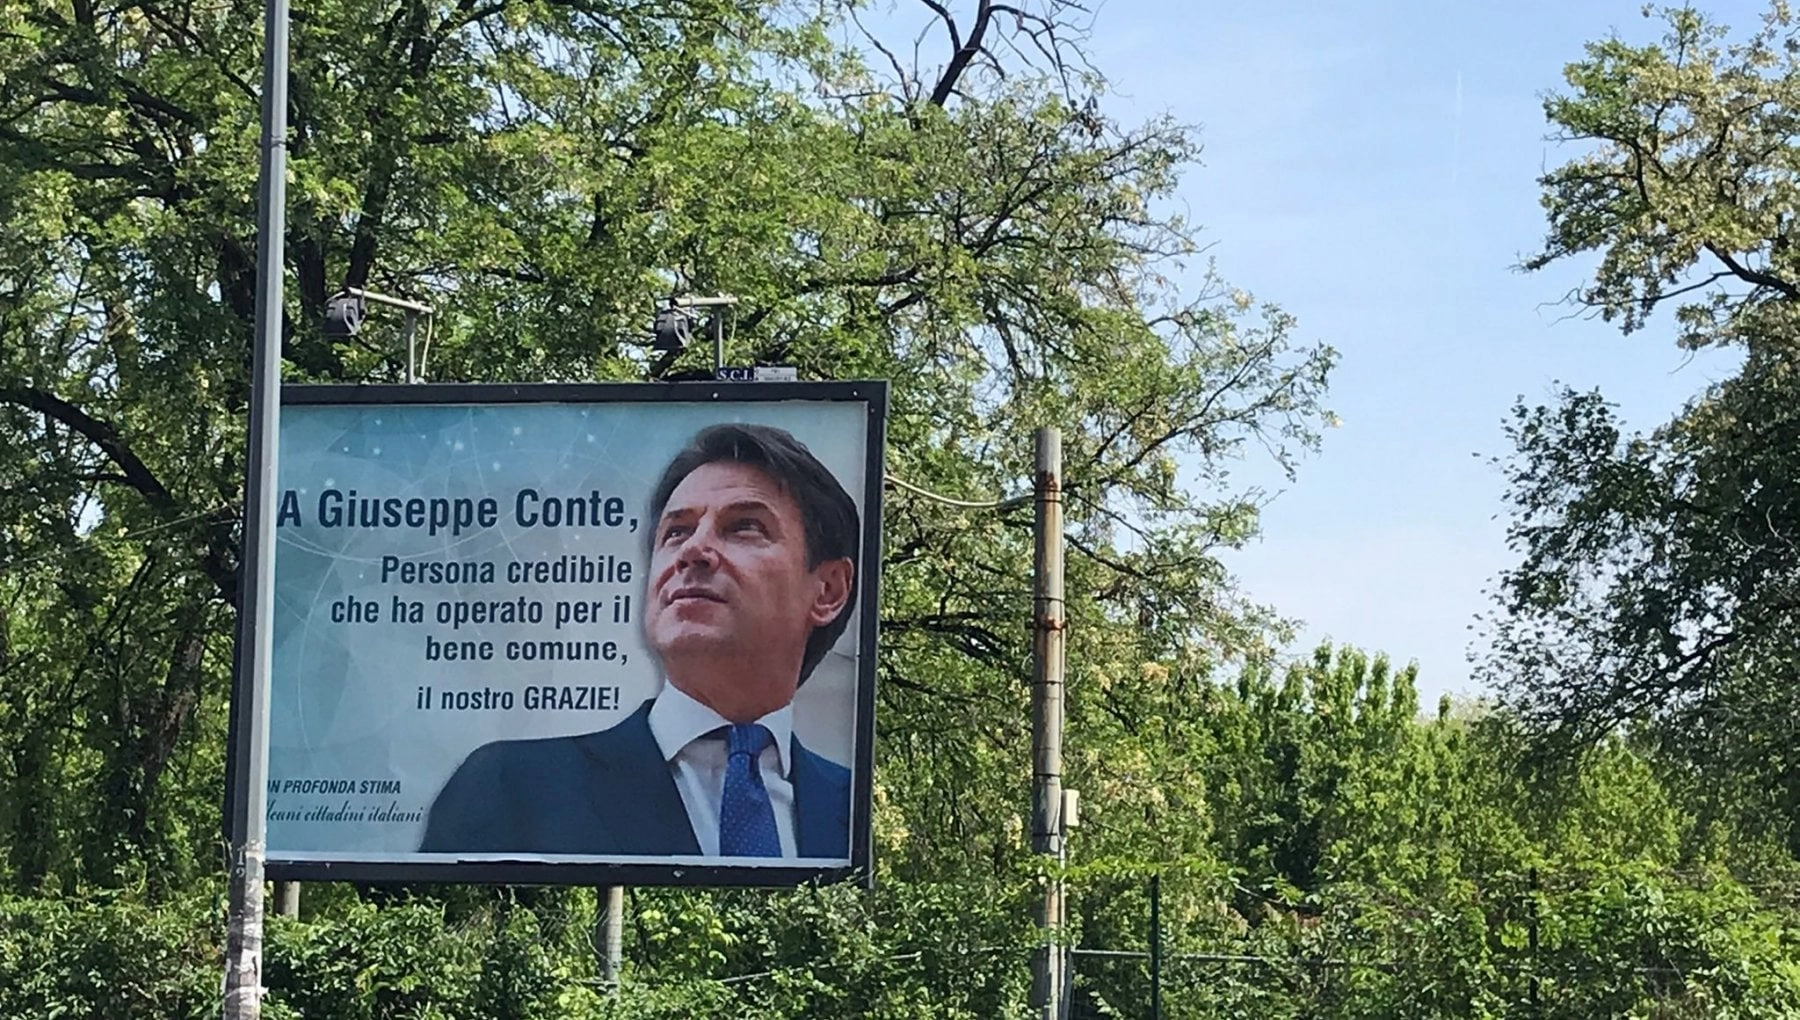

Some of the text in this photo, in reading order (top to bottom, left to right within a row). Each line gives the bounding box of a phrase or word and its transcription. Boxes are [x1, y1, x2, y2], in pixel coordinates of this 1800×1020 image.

[277, 488, 638, 536] A Giuseppe Conte,
[381, 555, 632, 584] Persona credibile
[331, 595, 630, 630] che ha operato per il
[426, 635, 628, 665] bene comune,
[417, 686, 619, 710] il nostro GRAZIE!
[283, 780, 356, 794] PROFONDA
[359, 780, 401, 794] STIMA
[304, 800, 367, 822] cittadini
[368, 800, 424, 822] italiani
